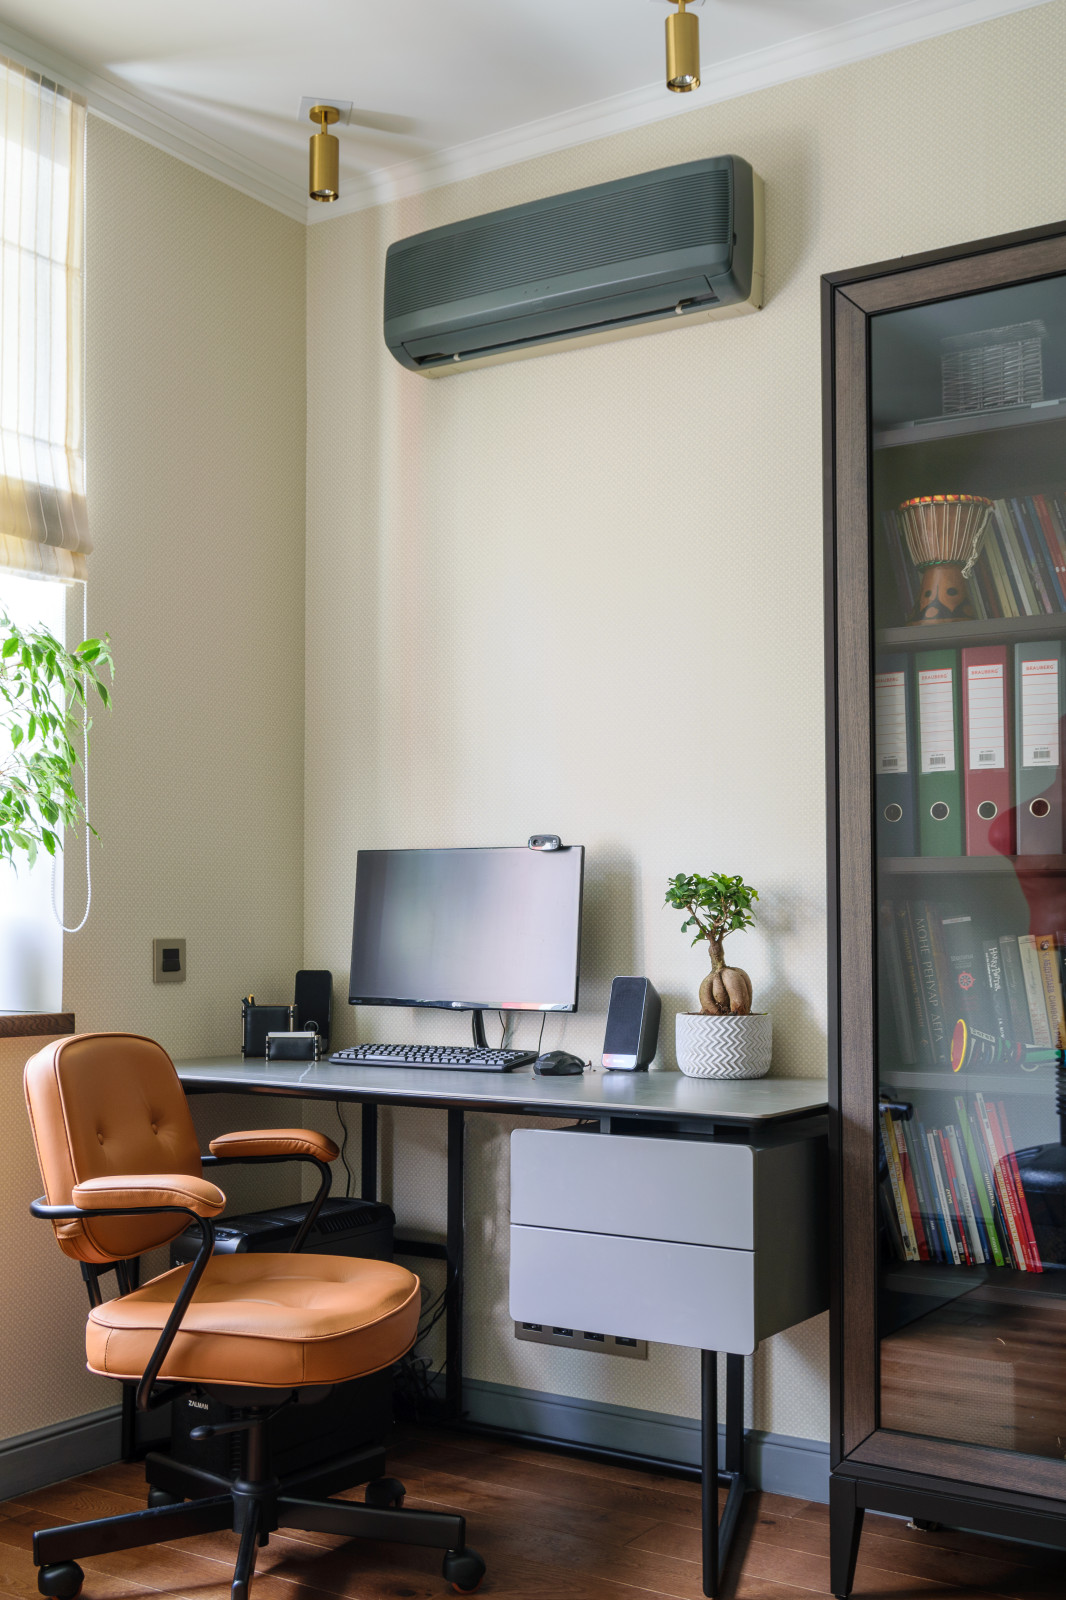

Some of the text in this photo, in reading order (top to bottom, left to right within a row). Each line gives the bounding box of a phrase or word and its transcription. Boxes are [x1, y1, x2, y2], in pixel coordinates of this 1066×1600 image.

[915, 918, 944, 1042] МОНЕ РЕНУАР ДЕГА
[188, 1399, 209, 1410] ZALMAN
